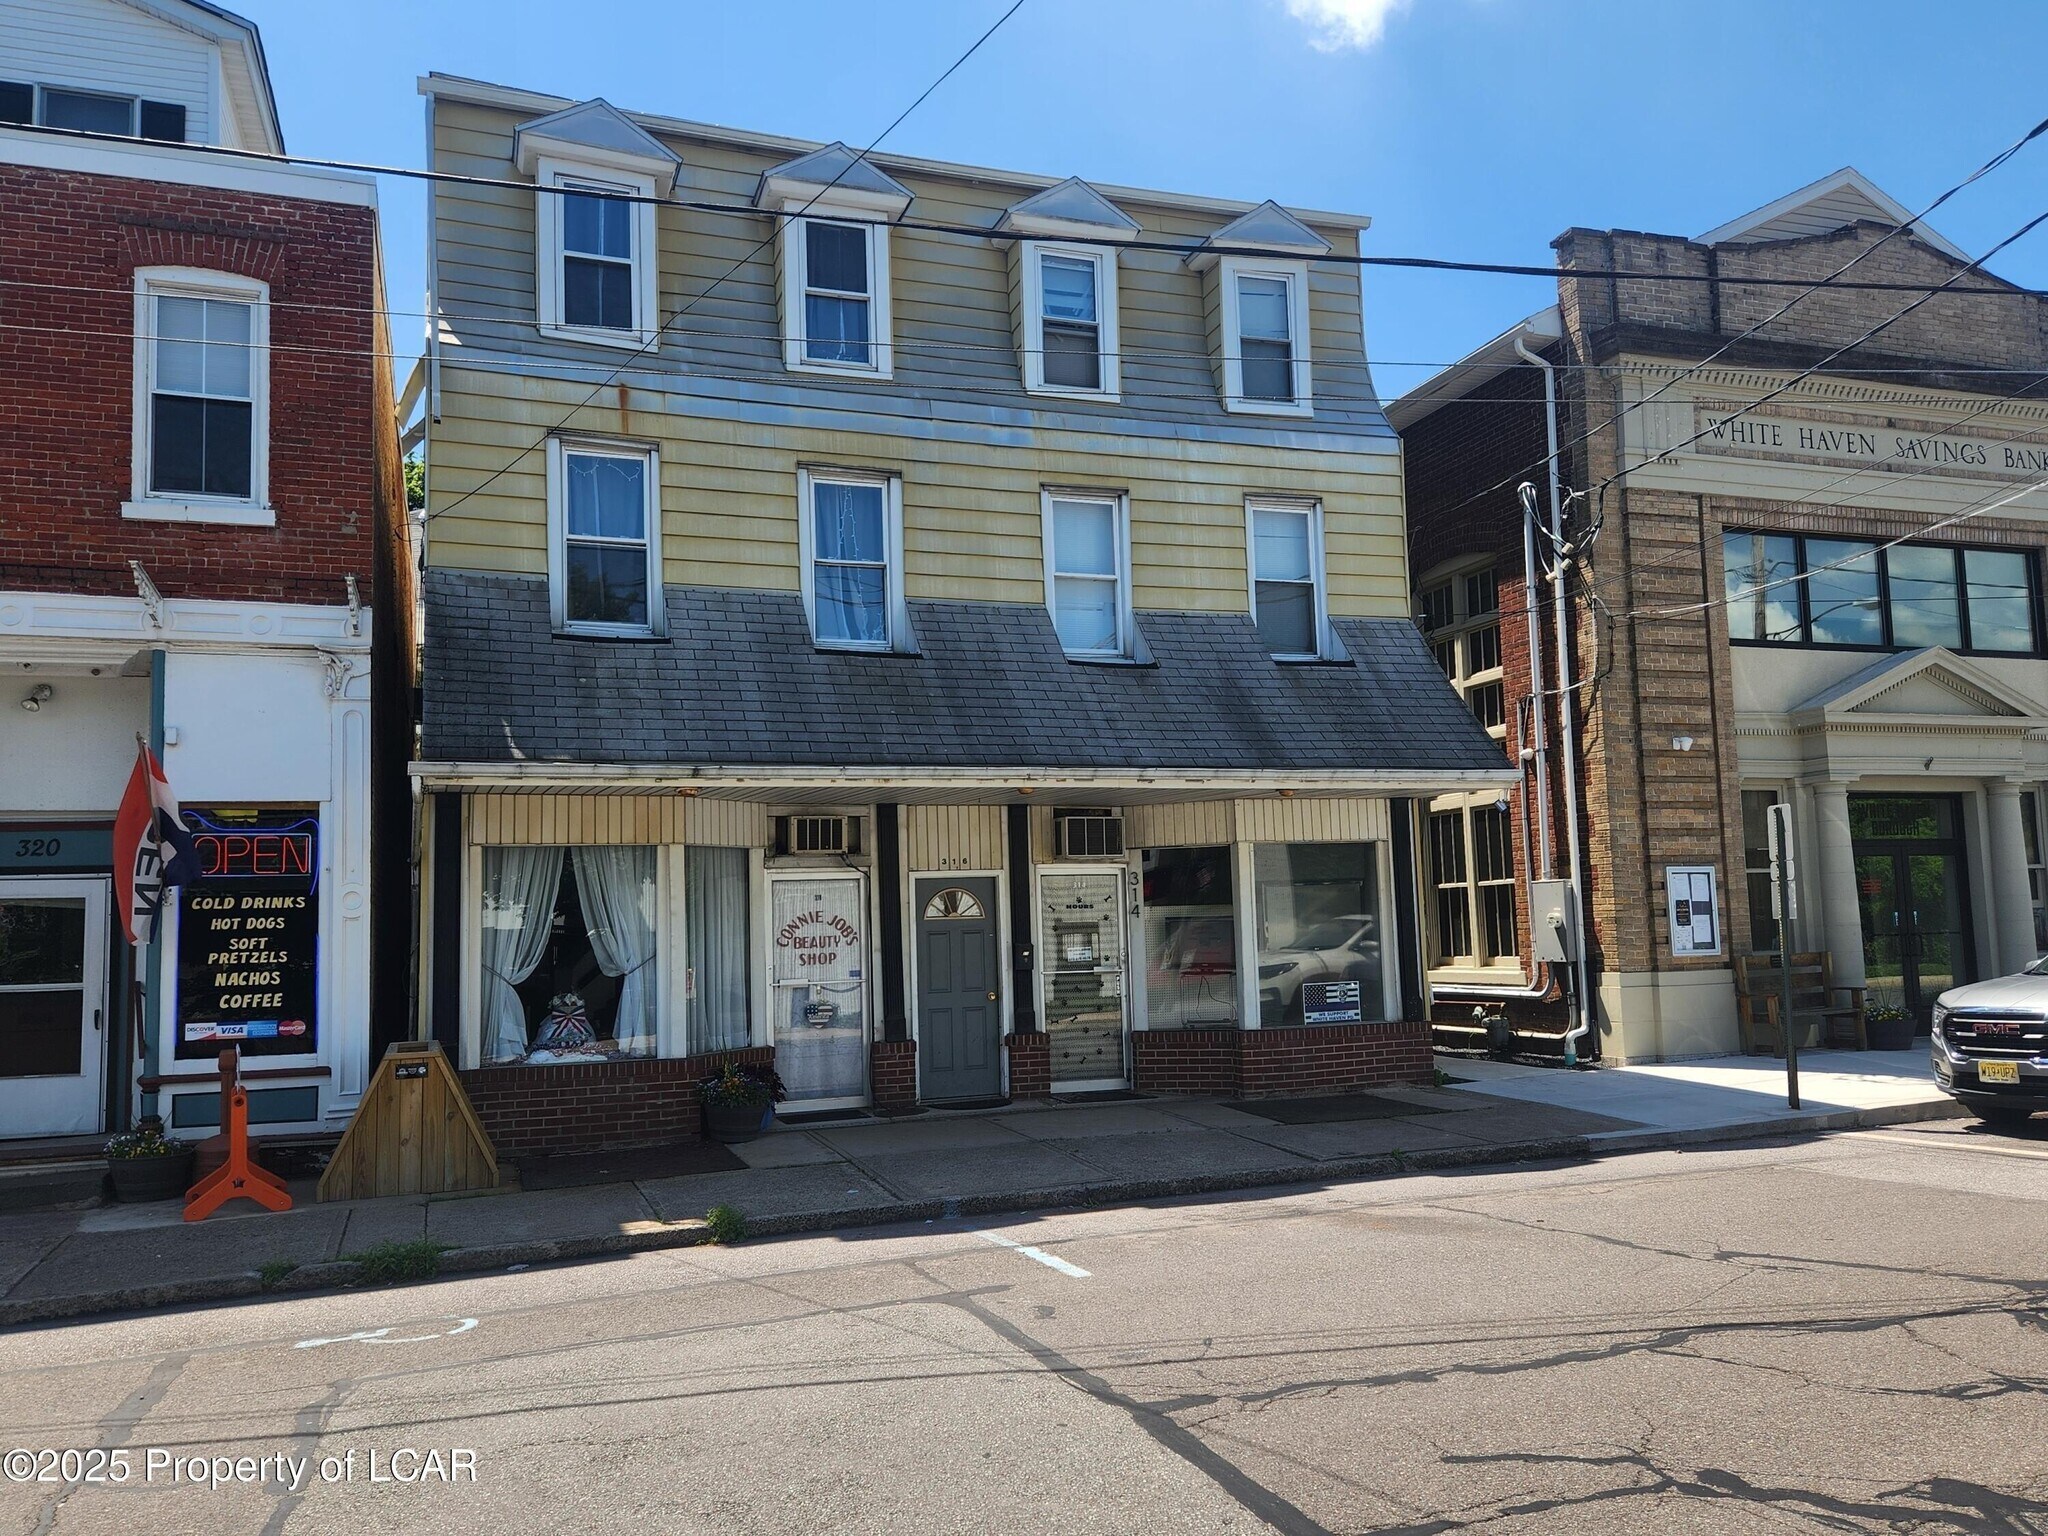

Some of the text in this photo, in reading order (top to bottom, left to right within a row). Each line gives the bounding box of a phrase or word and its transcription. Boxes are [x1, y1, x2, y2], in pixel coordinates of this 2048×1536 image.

[1707, 418, 1782, 446] WHITE
[1799, 427, 1875, 455] HAVEN
[1895, 437, 1987, 465] SAVINGS
[15, 838, 61, 857] 320
[194, 836, 309, 874] OPEN
[941, 857, 968, 865] 316
[1129, 871, 1140, 919] 314
[191, 896, 306, 910] COLD DRINKS
[210, 917, 285, 930] HOT DOGS
[776, 910, 859, 948] CONNIE JOB'S
[229, 937, 268, 950] SOFT
[793, 935, 841, 949] BEAUTY
[207, 951, 288, 965] PRETZELS
[799, 952, 837, 967] SHOP
[214, 971, 281, 987] NACHOS
[219, 992, 283, 1009] COFFEE
[221, 1026, 244, 1034] VISA
[1972, 1023, 2020, 1035] GMC
